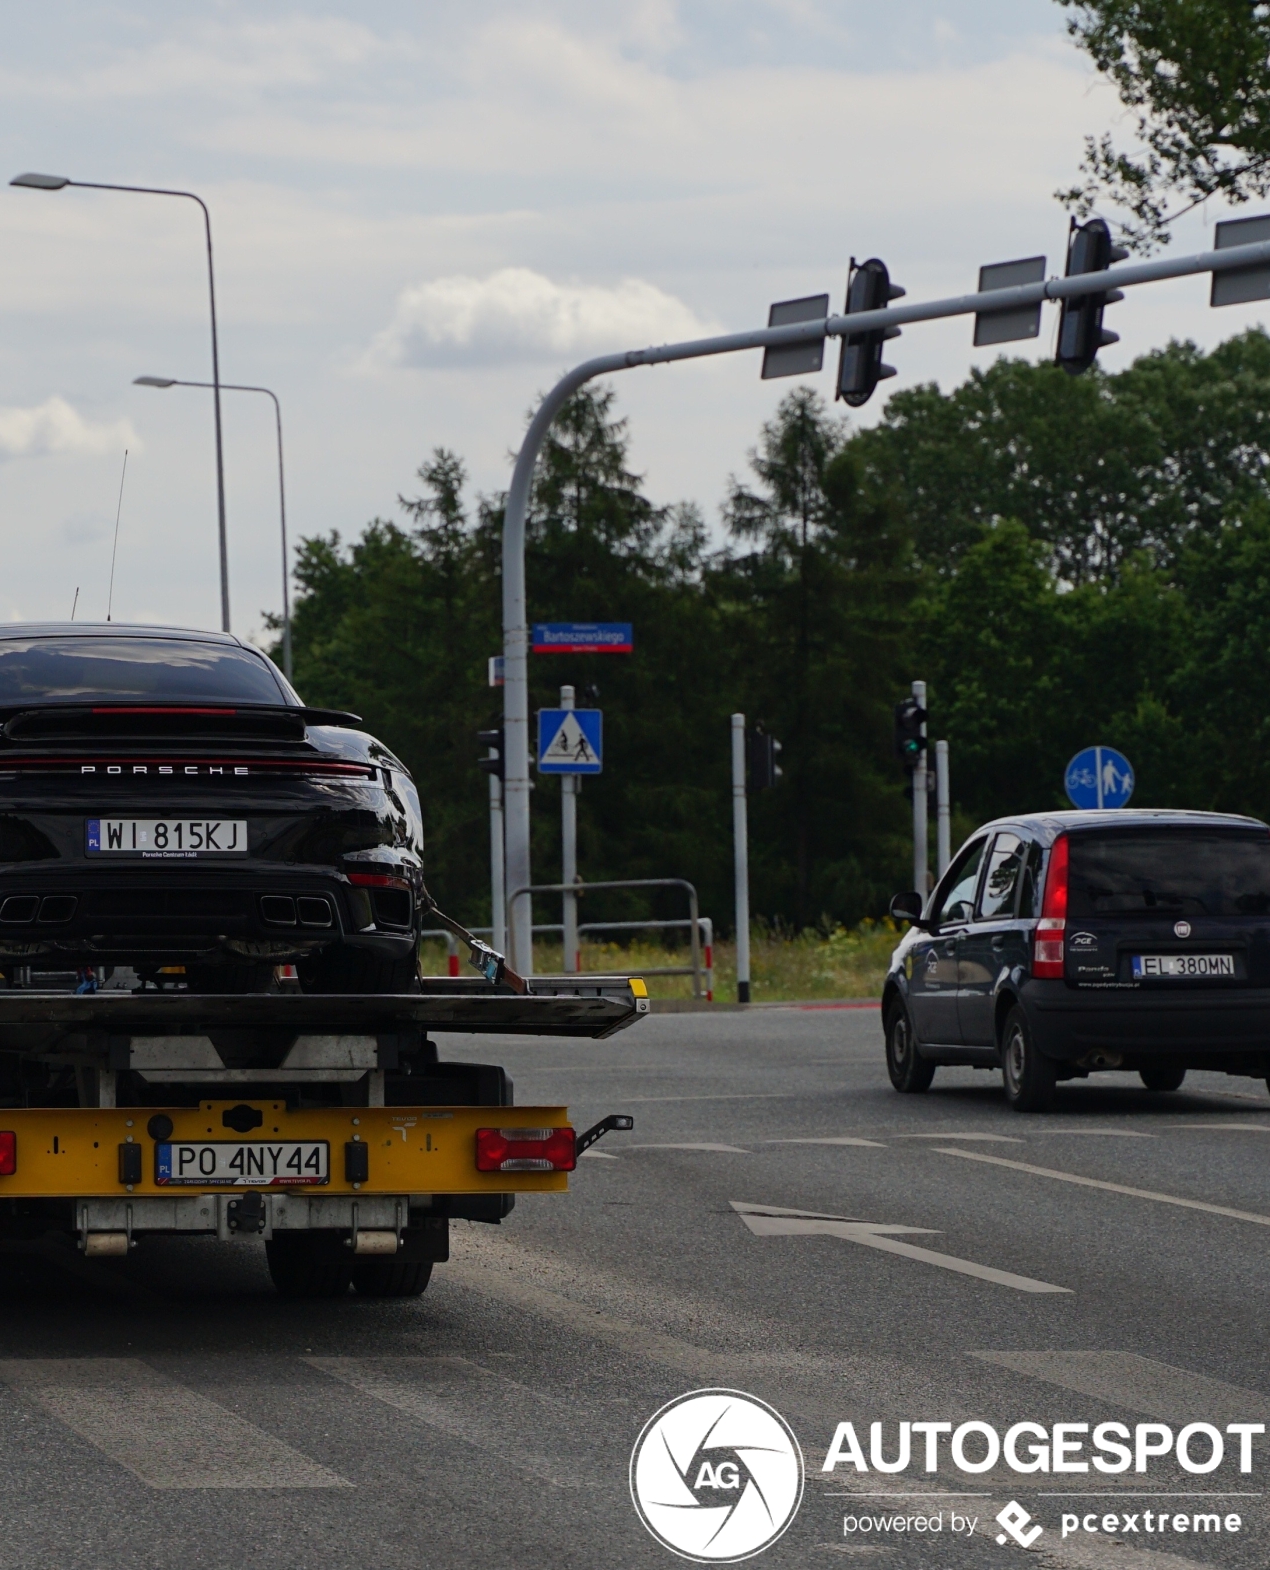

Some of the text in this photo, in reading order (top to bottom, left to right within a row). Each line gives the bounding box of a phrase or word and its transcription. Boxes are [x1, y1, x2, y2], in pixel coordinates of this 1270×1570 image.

[543, 630, 625, 645] Bartoszewskiego
[81, 766, 249, 775] PORSCHE
[107, 822, 238, 849] WI 815KJ
[88, 839, 99, 847] PL
[1074, 937, 1093, 945] PGE
[1077, 965, 1110, 973] Panda
[1144, 957, 1231, 975] EL 380MN
[178, 1146, 320, 1176] PO 4NY44
[159, 1165, 170, 1174] PL
